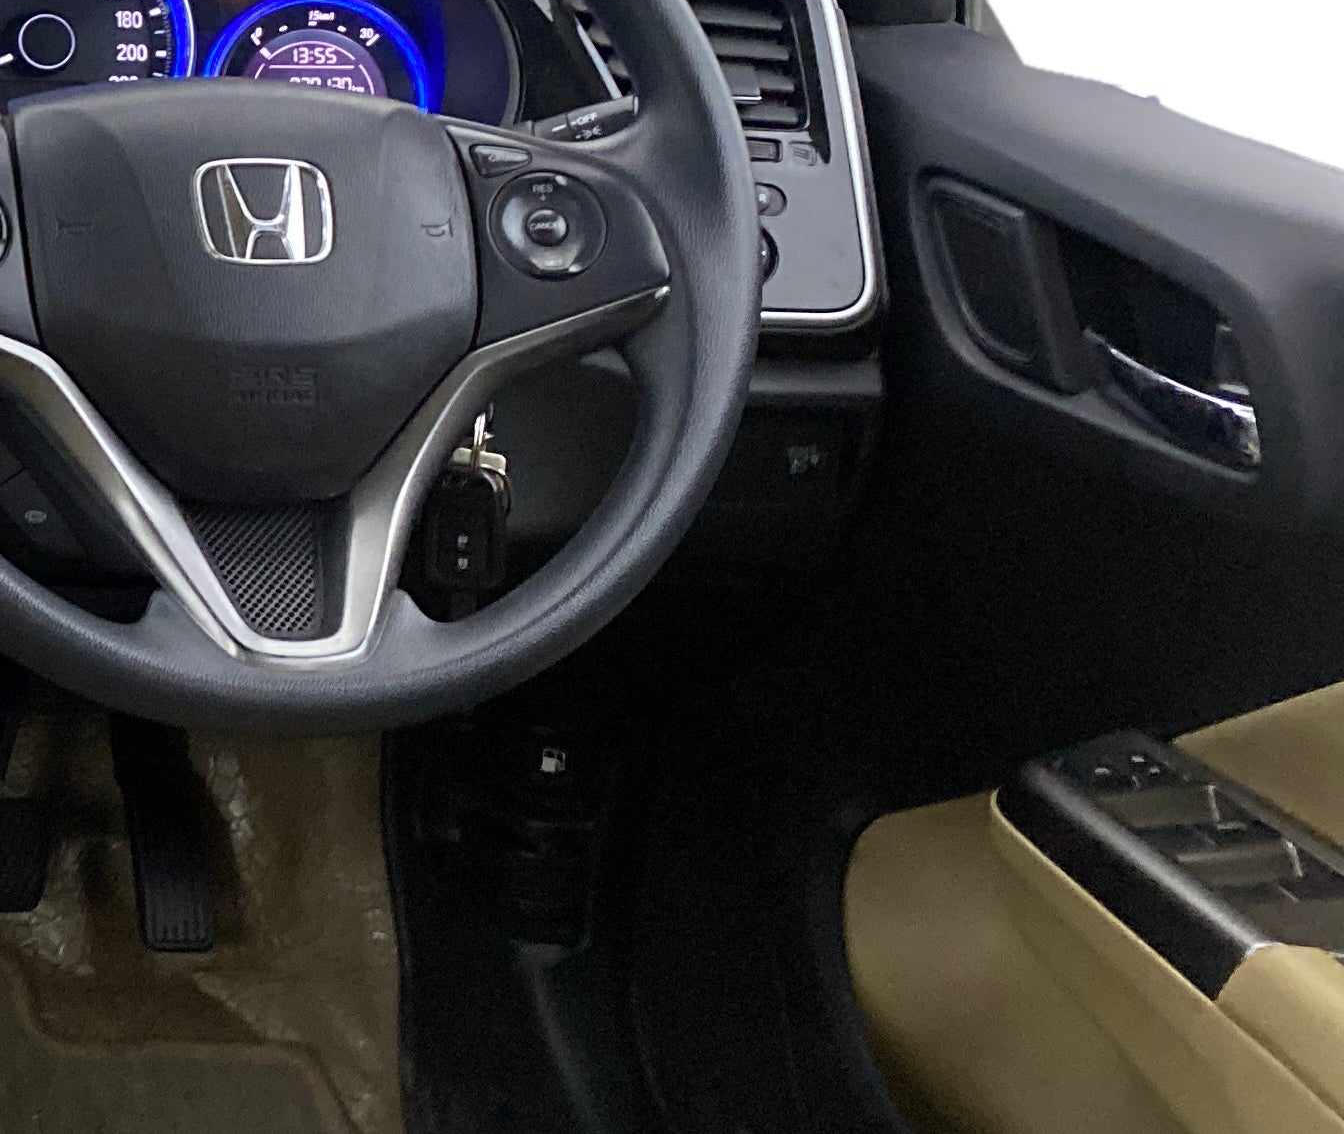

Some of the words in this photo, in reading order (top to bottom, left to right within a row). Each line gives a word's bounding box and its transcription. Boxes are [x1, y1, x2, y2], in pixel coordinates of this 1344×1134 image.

[115, 10, 143, 28] 180
[359, 27, 374, 39] 30
[116, 44, 148, 61] 200
[292, 47, 337, 64] 13:55
